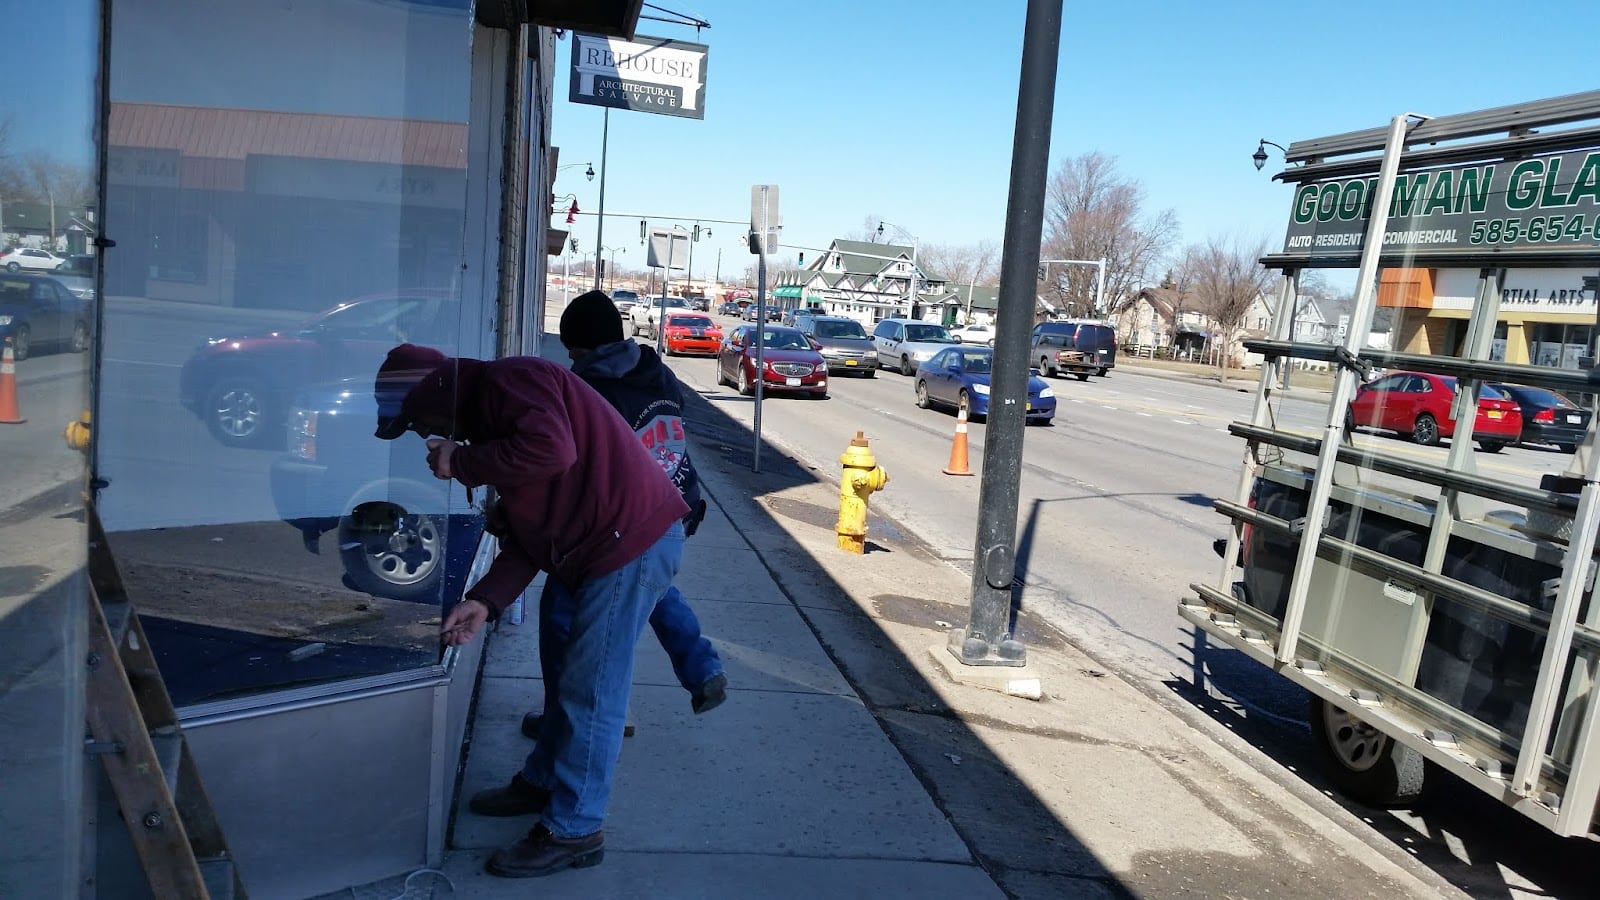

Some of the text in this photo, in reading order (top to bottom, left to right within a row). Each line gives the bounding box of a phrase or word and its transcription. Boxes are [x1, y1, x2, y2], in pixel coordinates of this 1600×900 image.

[586, 47, 693, 79] REHOUSE
[598, 89, 676, 107] SALVAGE
[599, 80, 676, 98] ARCHITECTURAL
[1504, 151, 1600, 211] GLA
[1288, 229, 1458, 248] AUTO RESIDENT COMMERCIAL
[1501, 288, 1540, 305] RTIAL
[1547, 289, 1585, 305] ARTS
